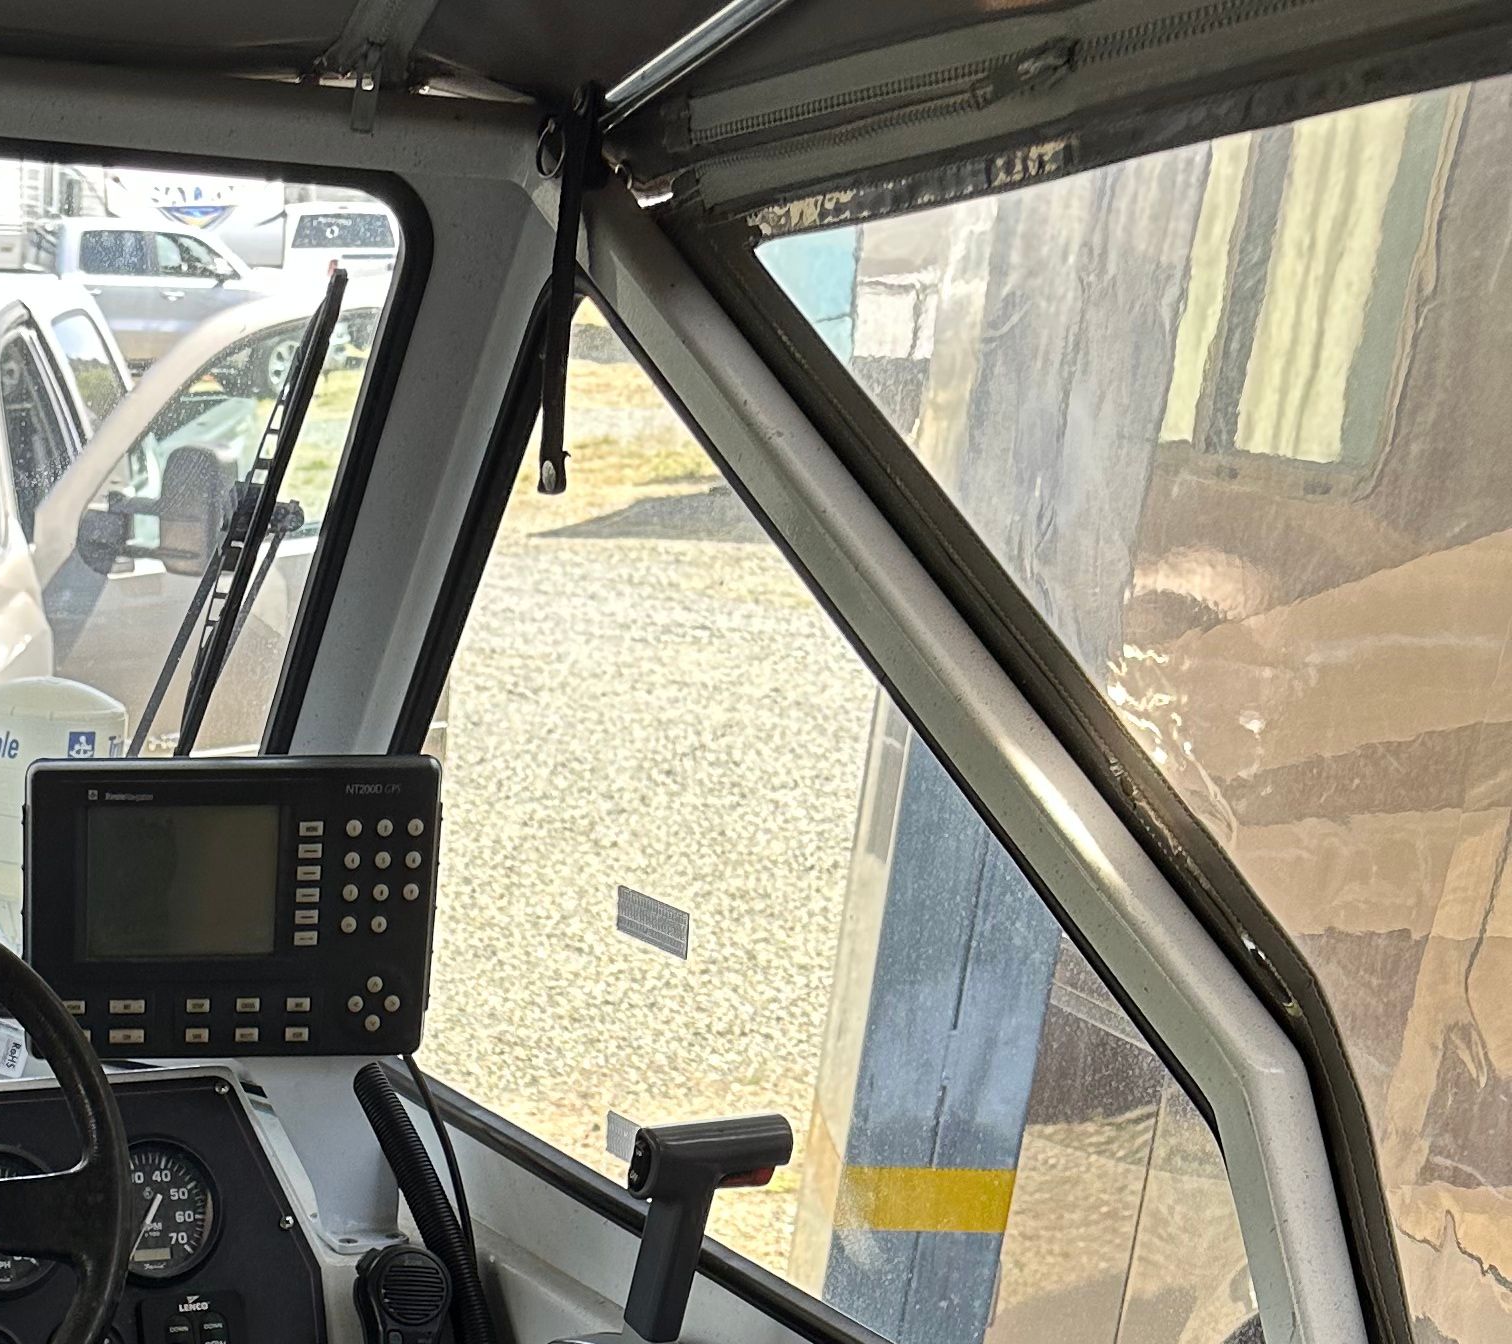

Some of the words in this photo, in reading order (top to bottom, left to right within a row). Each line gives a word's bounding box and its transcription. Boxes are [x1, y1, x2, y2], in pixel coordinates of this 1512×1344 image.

[5, 1041, 23, 1070] RoHS
[152, 1170, 171, 1182] 40
[170, 1187, 188, 1200] 50
[175, 1210, 194, 1223] 60
[169, 1231, 188, 1245] 70
[178, 1301, 209, 1312] LENCO
